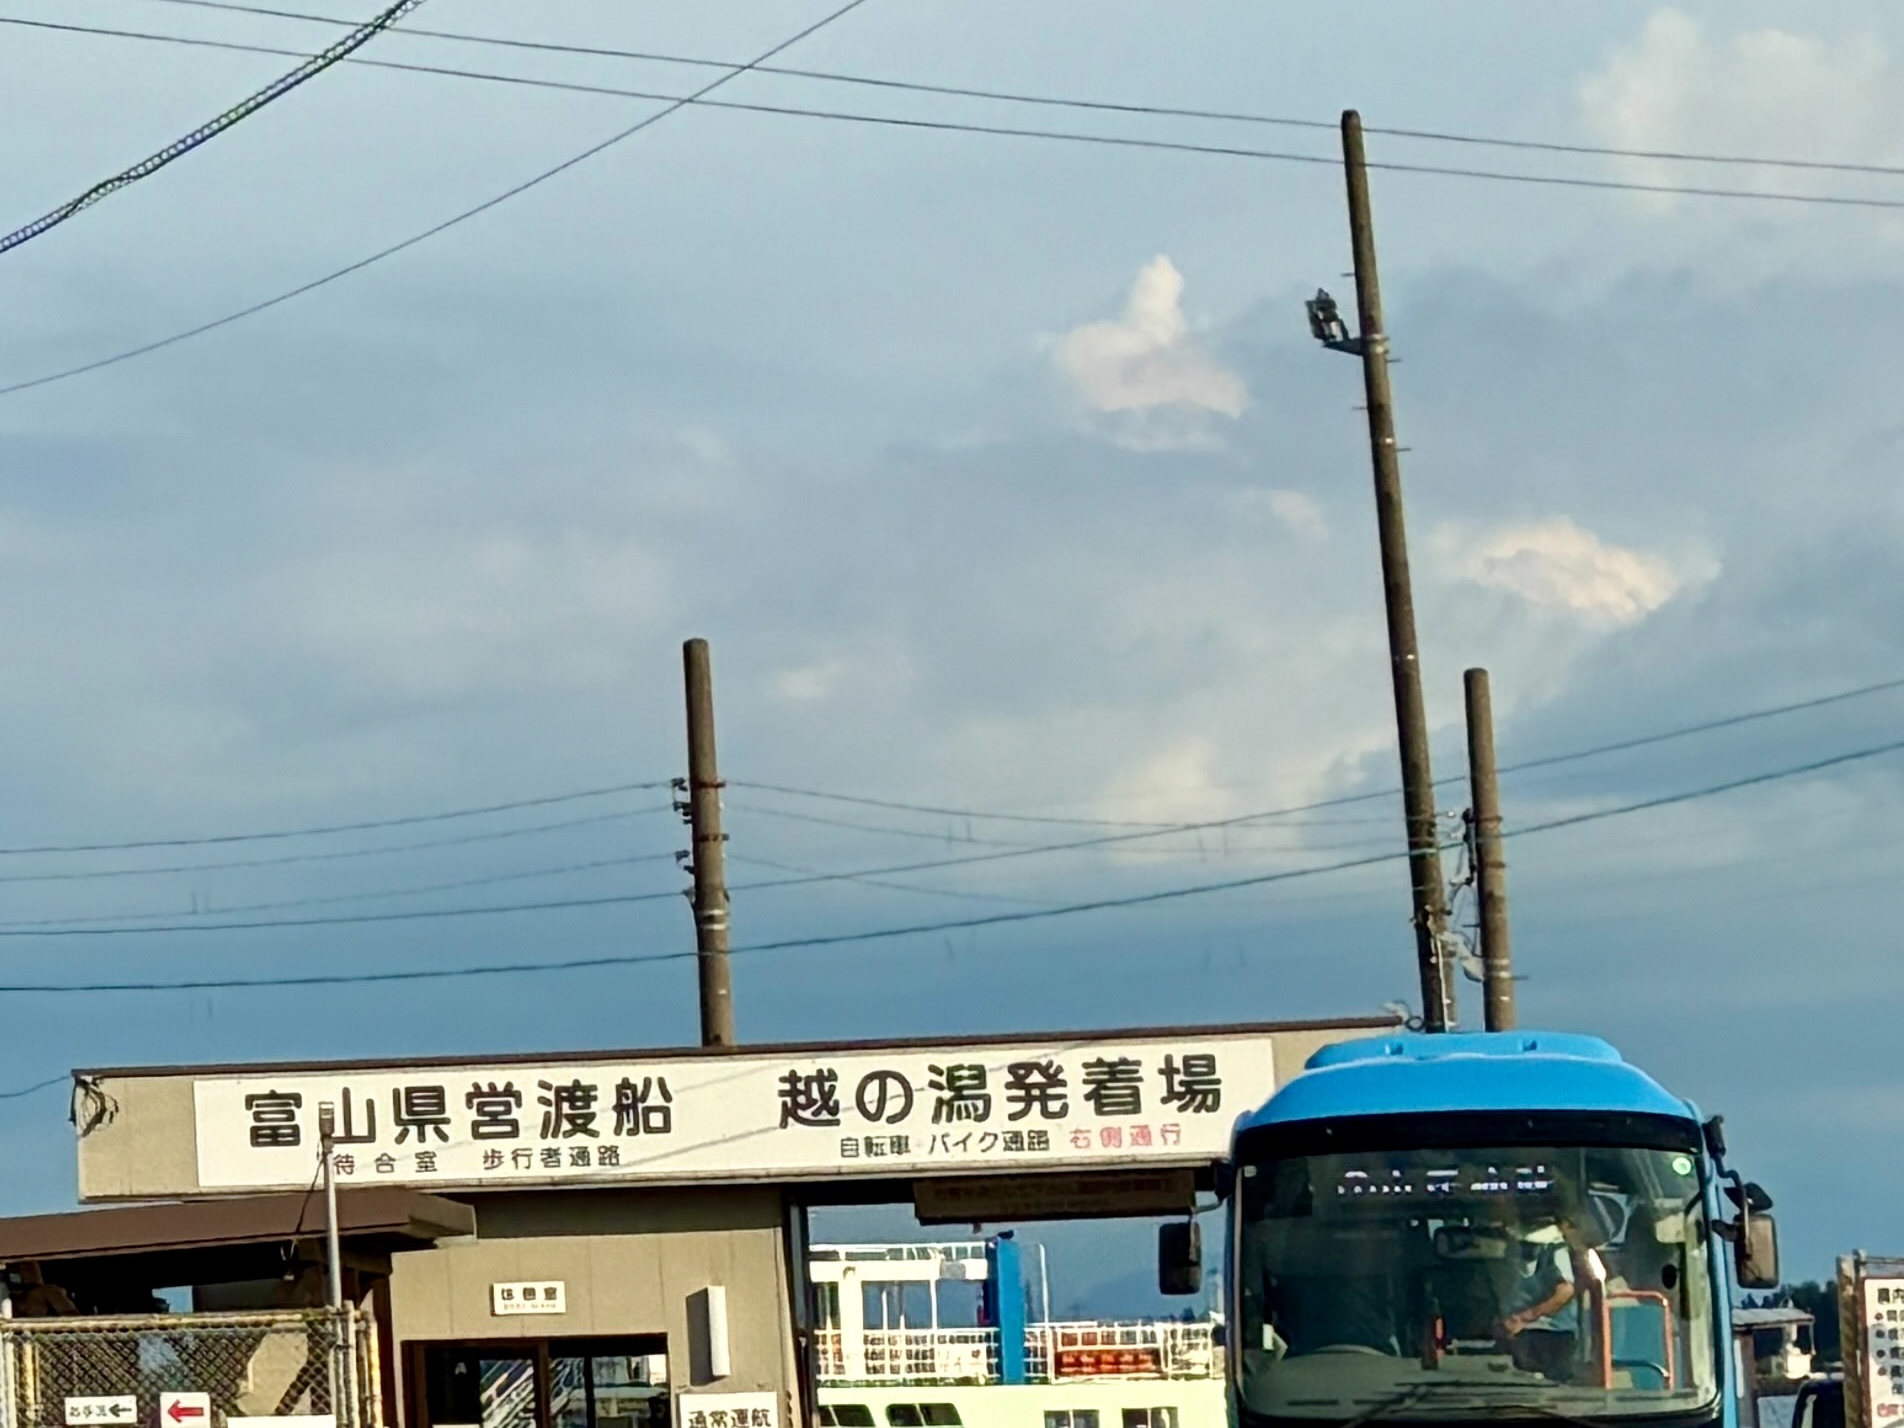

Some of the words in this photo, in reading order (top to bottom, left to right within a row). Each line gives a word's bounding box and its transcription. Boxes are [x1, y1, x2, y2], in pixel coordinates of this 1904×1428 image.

[244, 1075, 673, 1148] 富山県営渡船
[777, 1053, 1223, 1129] 越の潟発着場
[481, 1143, 621, 1172] 歩行者通路
